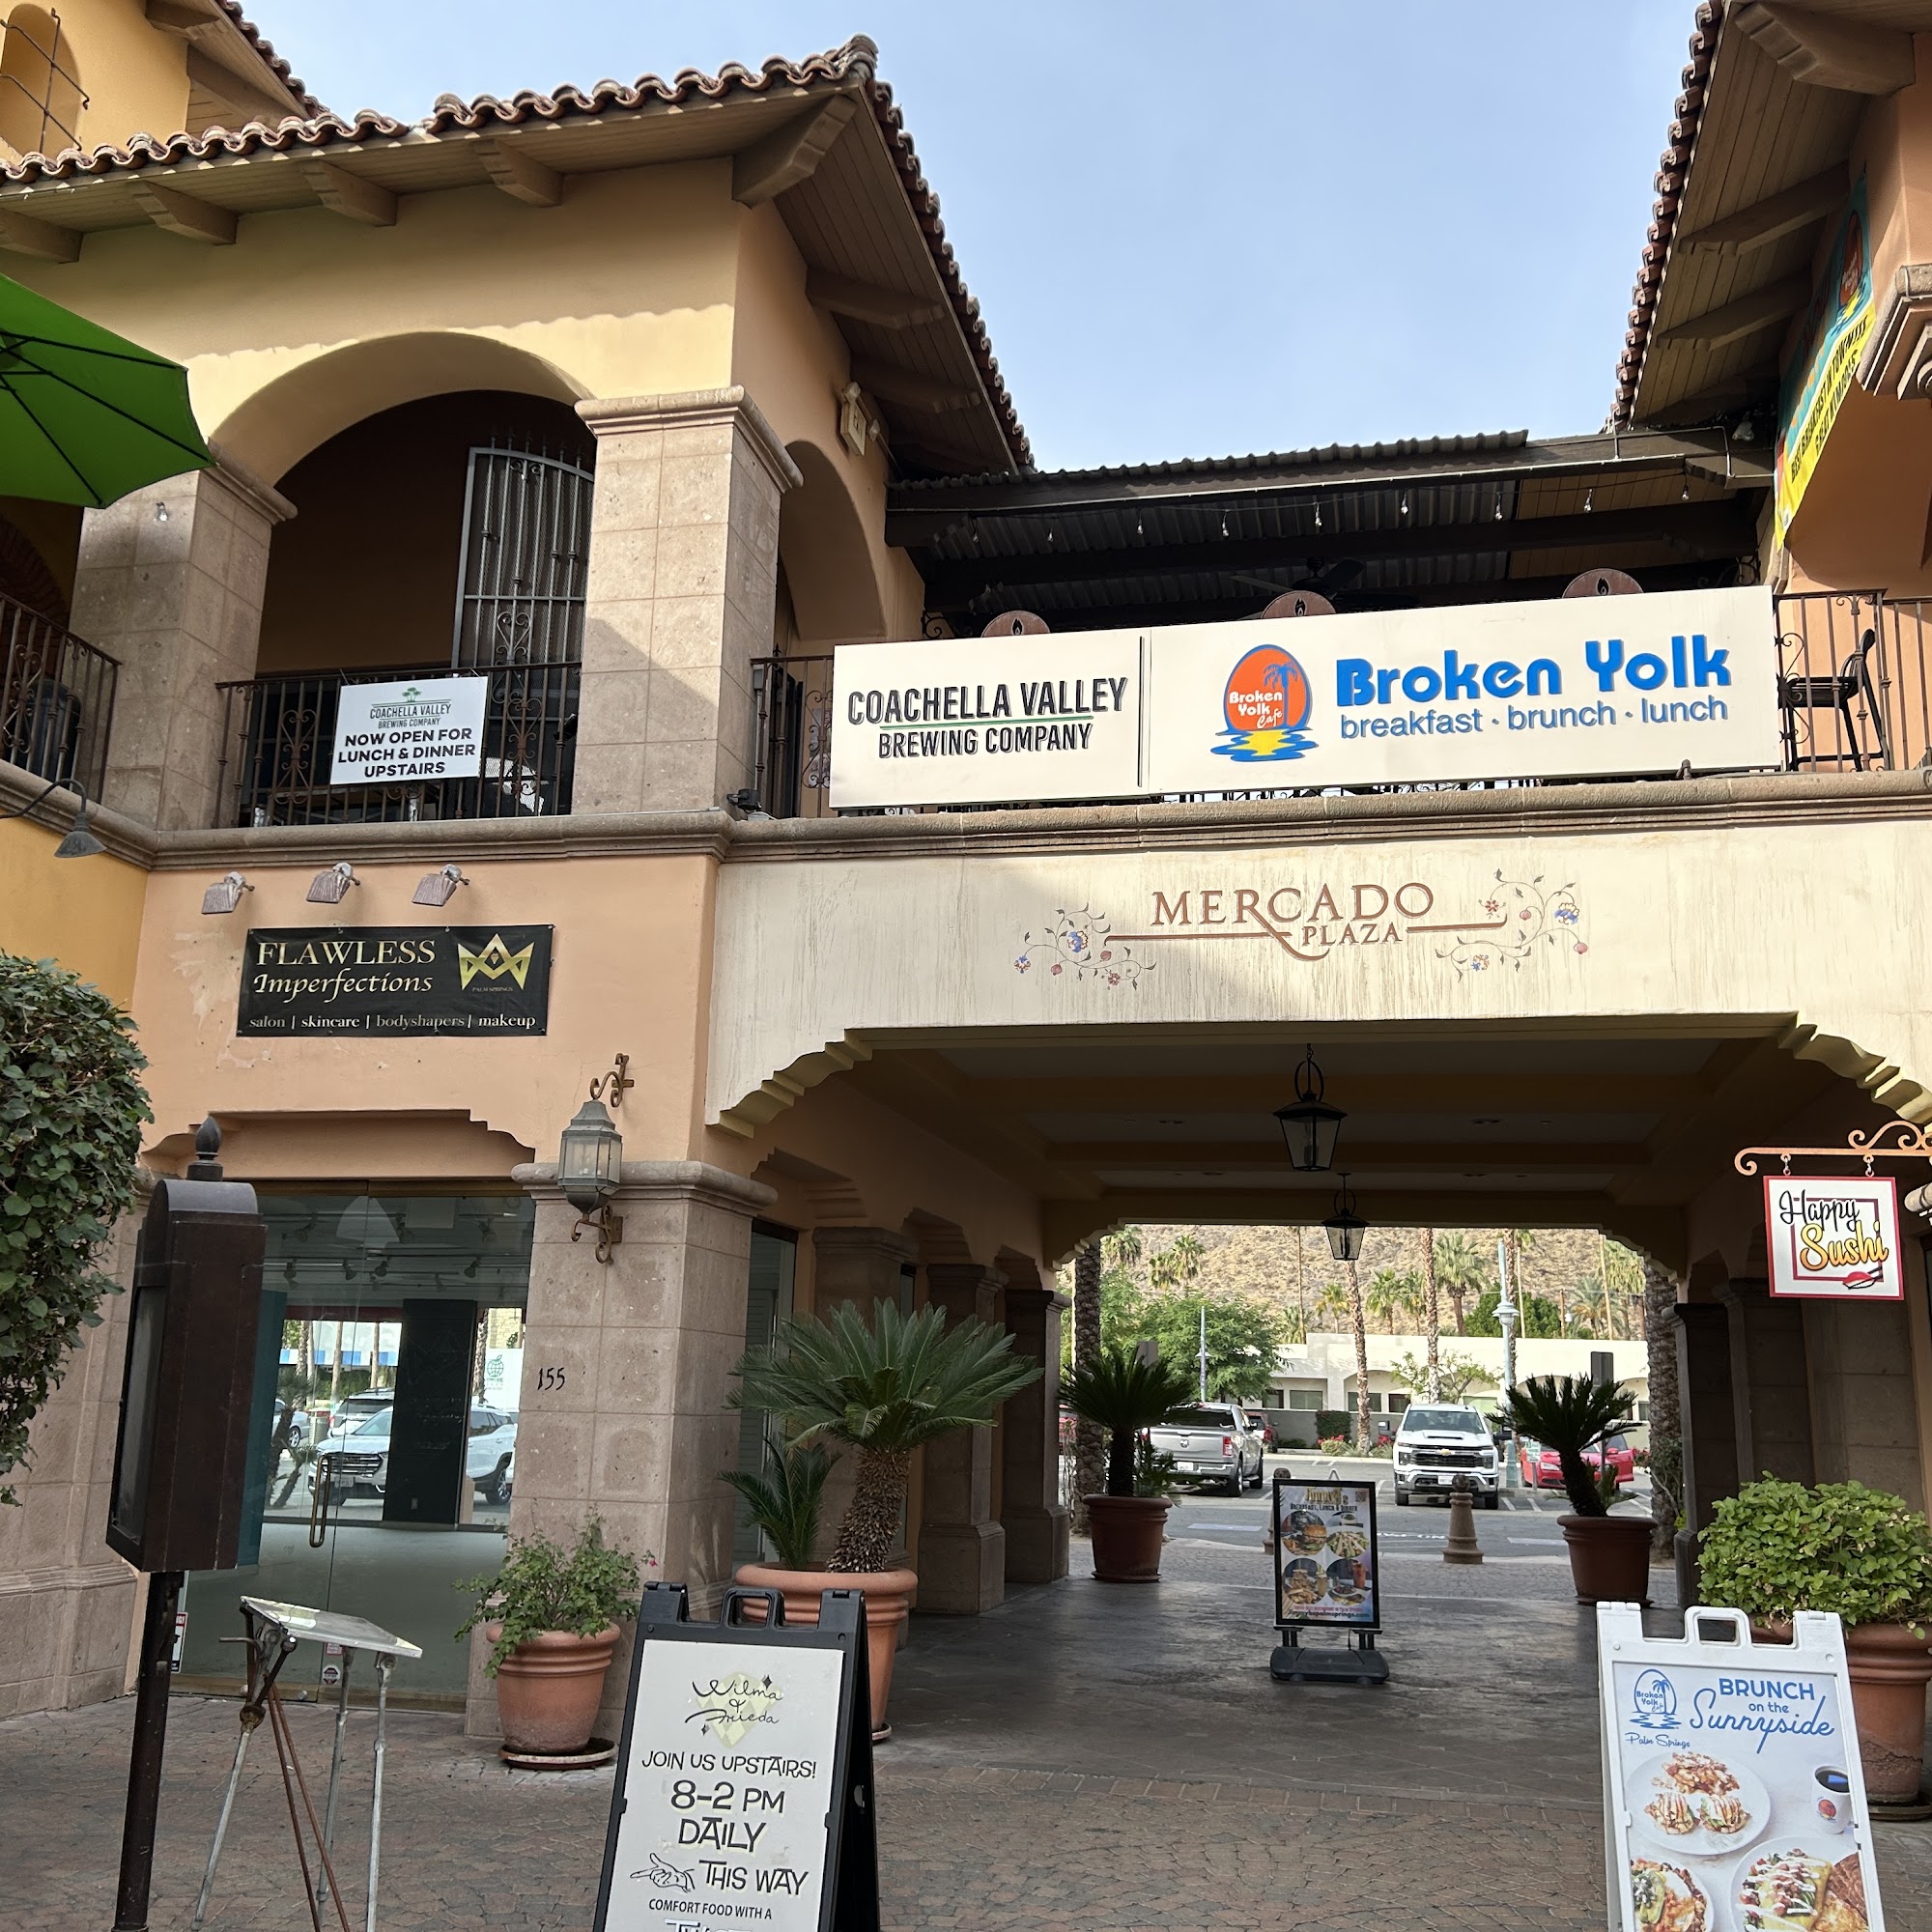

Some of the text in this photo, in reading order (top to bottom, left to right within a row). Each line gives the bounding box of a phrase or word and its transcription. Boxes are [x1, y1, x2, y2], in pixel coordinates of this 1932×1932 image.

[1336, 634, 1732, 707] Broken Yolk
[847, 677, 1128, 725] COACHELLA VALLEY
[1229, 690, 1283, 704] Broken
[370, 703, 451, 719] COACHELLA VALLEY
[1237, 702, 1270, 717] Yolk
[1341, 695, 1729, 740] breakfast brunch lunch
[378, 717, 440, 729] BREWING COMPANY
[345, 727, 472, 747] NOW OPEN FOR
[878, 724, 1094, 758] BREWING COMPANY
[338, 744, 476, 763] LUNCH & DINNER
[364, 761, 445, 777] UPSTAIRS
[1151, 882, 1435, 959] MERCADO
[1301, 922, 1403, 947] PLAZA
[256, 940, 436, 965] FLAWLESS
[253, 967, 434, 1004] Imperfections
[249, 1013, 536, 1031] salon skincare bodyshapers makeup
[1778, 1189, 1861, 1233] Happy
[1800, 1219, 1889, 1272] Sushi
[537, 1367, 565, 1390] 155
[692, 1679, 783, 1701] Wilma
[1719, 1678, 1815, 1700] BRUNCH
[684, 1708, 780, 1724] Frieda
[1748, 1701, 1789, 1713] on the
[1690, 1688, 1834, 1754] Sunnyside
[1625, 1732, 1690, 1749] Palm Springs
[641, 1749, 817, 1778] JOIN US UPSTAIRS!
[670, 1779, 785, 1814] 8-2 PM
[678, 1816, 767, 1853] DAILY
[698, 1860, 810, 1896] THIS WAY
[649, 1898, 772, 1919] COMFORT FOOD WITH A
